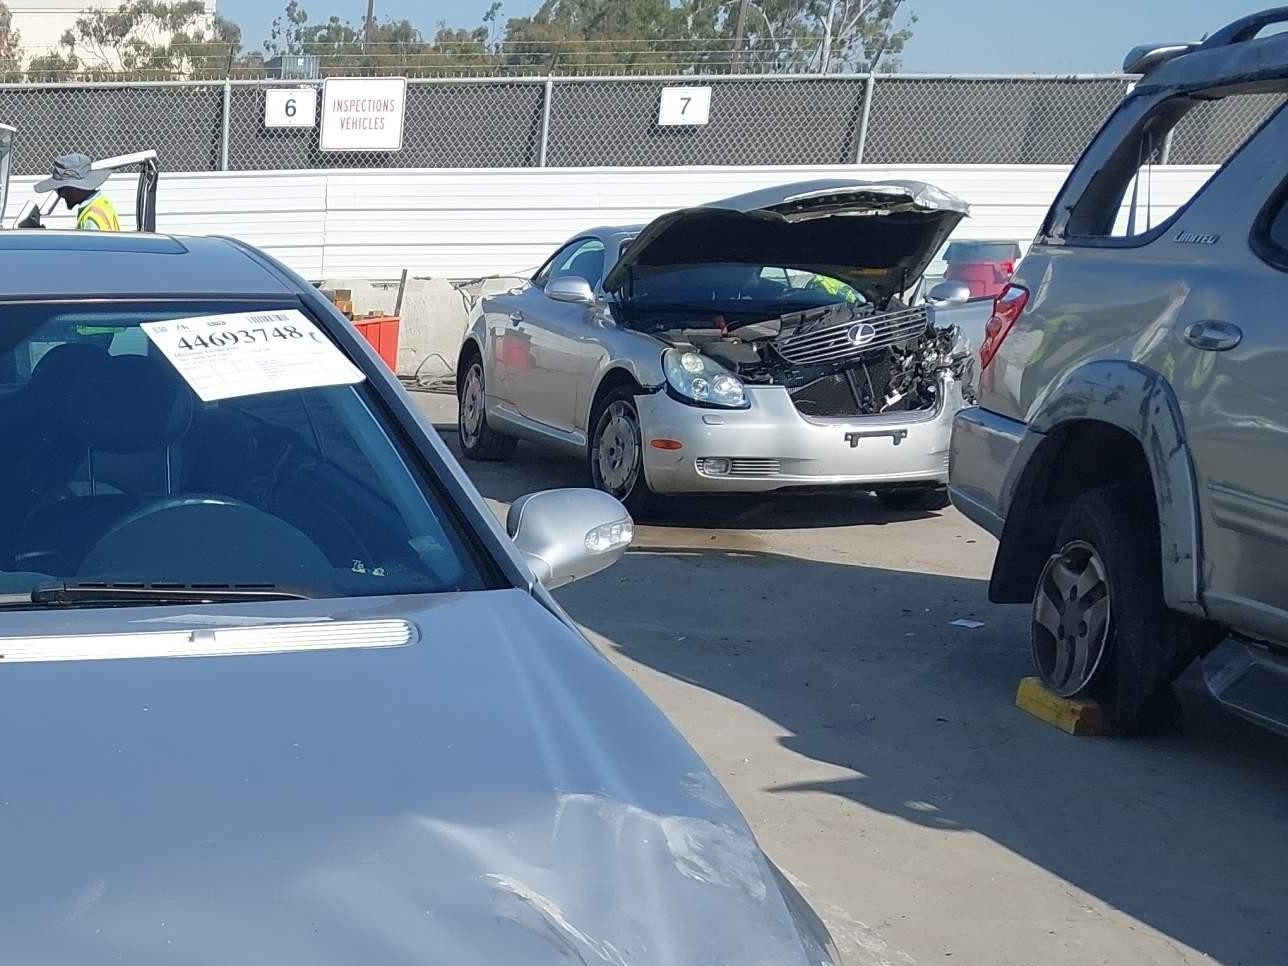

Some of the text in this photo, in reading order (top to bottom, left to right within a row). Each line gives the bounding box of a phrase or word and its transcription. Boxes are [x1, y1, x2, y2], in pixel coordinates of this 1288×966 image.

[284, 99, 297, 117] 6
[332, 98, 395, 113] INSPECTIONS
[680, 97, 692, 115] 7
[339, 117, 385, 130] VEHICLES
[177, 325, 304, 350] 44693748
